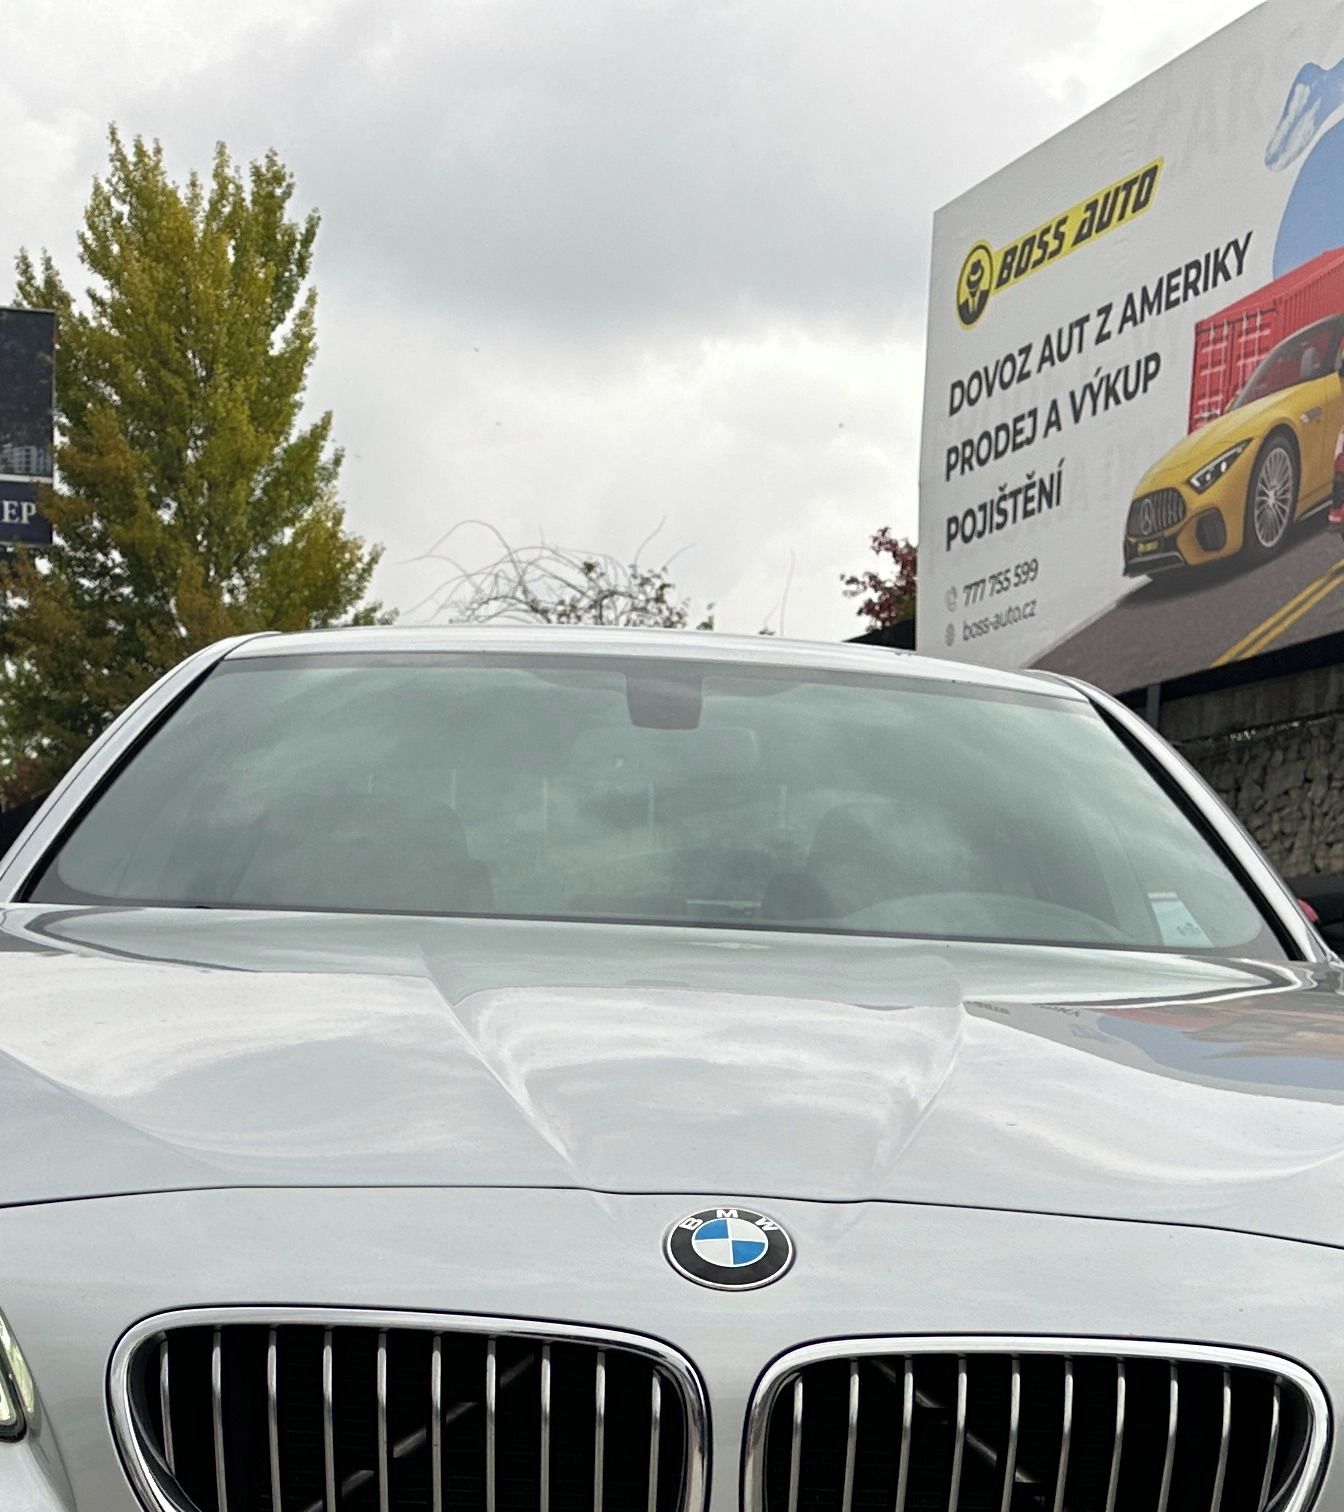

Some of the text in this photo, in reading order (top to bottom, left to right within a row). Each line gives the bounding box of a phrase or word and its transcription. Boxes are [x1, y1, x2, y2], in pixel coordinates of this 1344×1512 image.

[995, 164, 1159, 290] BOSS AUTO
[948, 229, 1254, 418] DOVOZ AUT Z AMERIKY
[944, 351, 1162, 483] PRODEJ A VÝKUP
[944, 456, 1065, 552] POJIŠTĚNÍ
[679, 1209, 778, 1231] BMW
